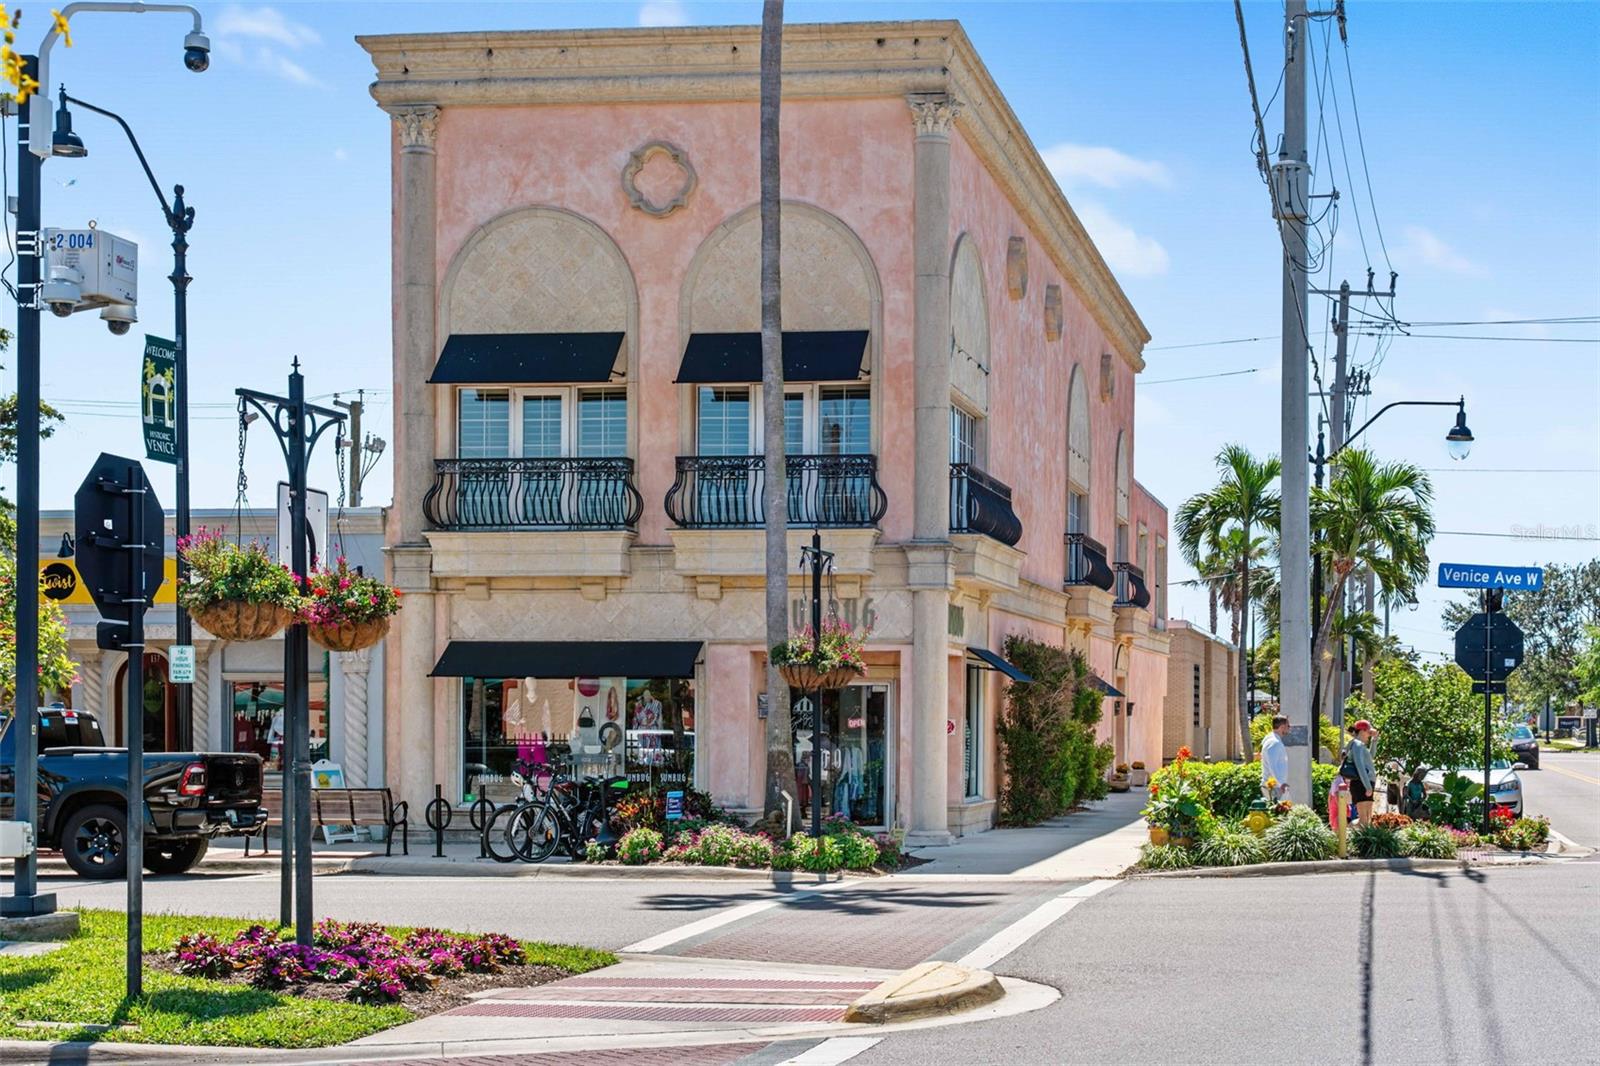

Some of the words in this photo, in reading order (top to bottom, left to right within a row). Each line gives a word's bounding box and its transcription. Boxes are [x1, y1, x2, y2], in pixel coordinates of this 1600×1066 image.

[146, 344, 175, 360] WELCOME
[146, 438, 175, 455] VENICE
[1444, 568, 1489, 583] Venice
[1494, 572, 1522, 585] Ave
[1526, 572, 1538, 586] W
[660, 773, 687, 782] SUNBUG
